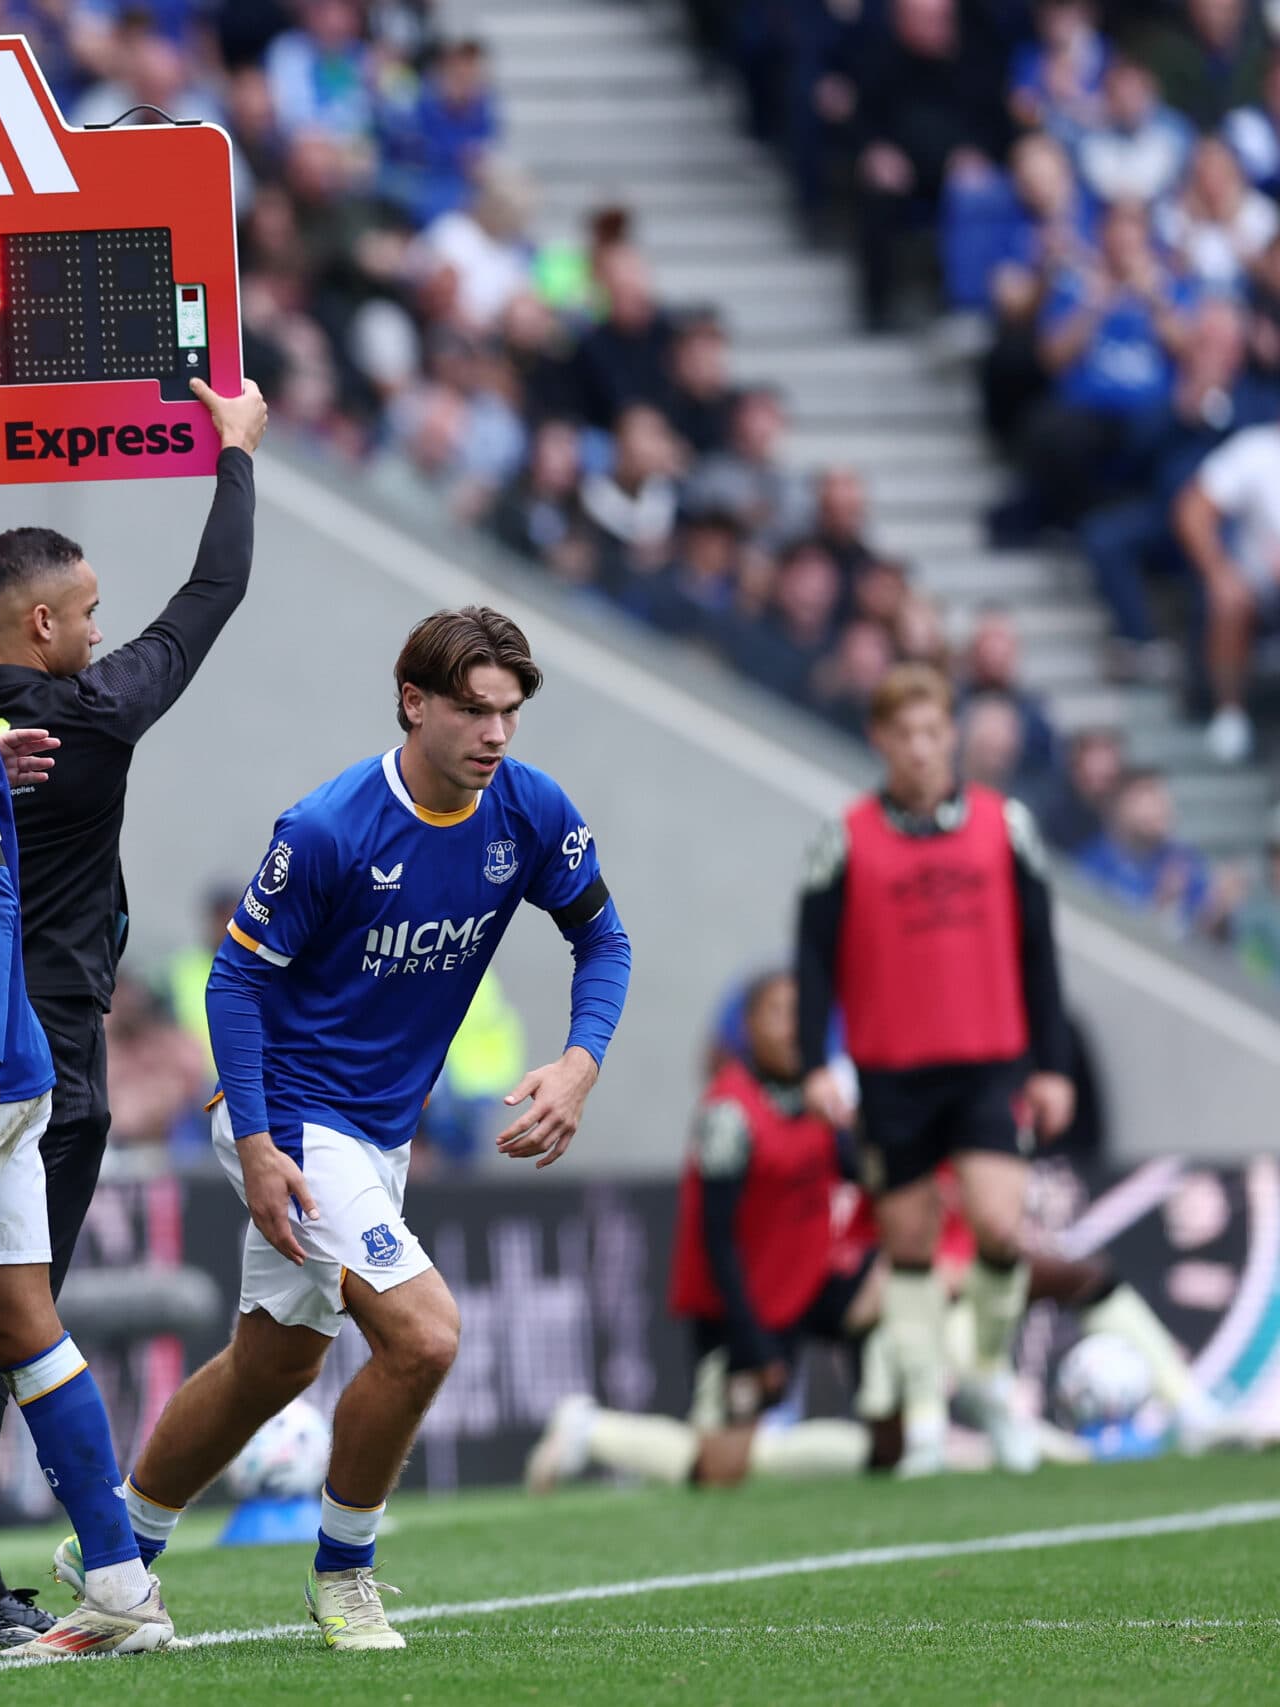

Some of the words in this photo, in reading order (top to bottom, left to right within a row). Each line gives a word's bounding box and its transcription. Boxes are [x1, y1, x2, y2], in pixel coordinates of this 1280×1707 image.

[5, 421, 195, 466] Express
[561, 825, 592, 870] Sta
[410, 910, 497, 955] CMC
[361, 942, 480, 978] MARKETS
